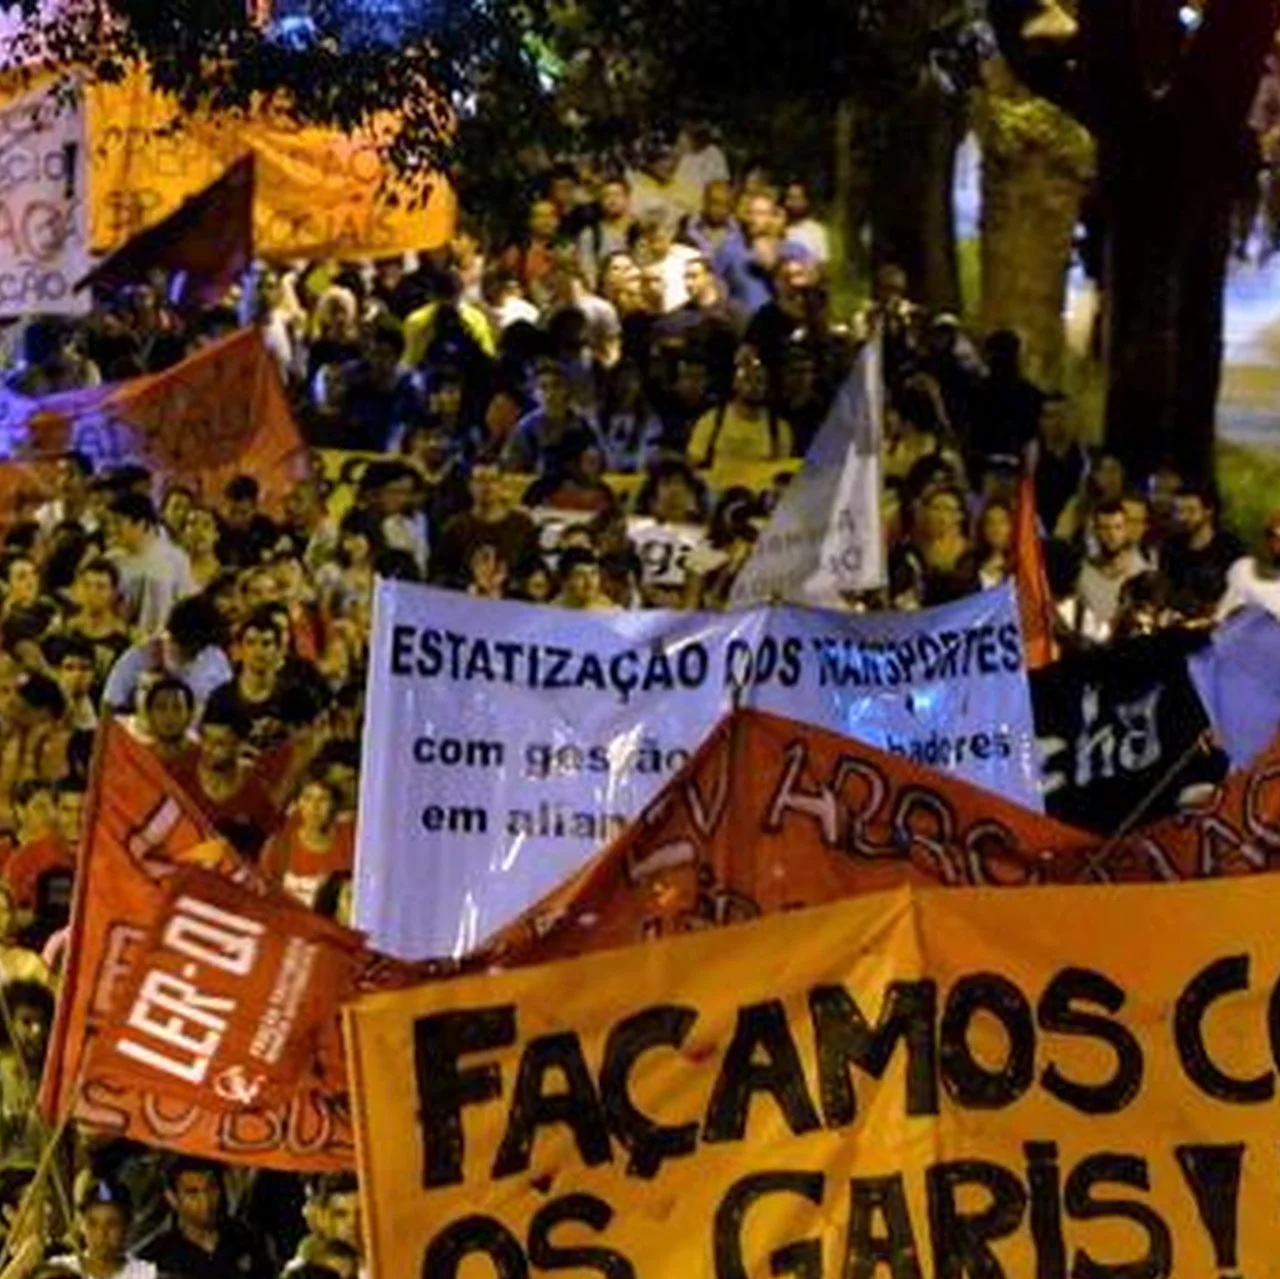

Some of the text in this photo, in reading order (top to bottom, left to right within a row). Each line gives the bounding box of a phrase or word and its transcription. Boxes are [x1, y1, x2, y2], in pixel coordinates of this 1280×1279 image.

[390, 625, 710, 703] ESTATIZAÇÃO
[412, 735, 505, 767] com
[525, 733, 690, 778] gesão
[421, 803, 489, 834] em
[413, 966, 1146, 1192] FAÇAMOS
